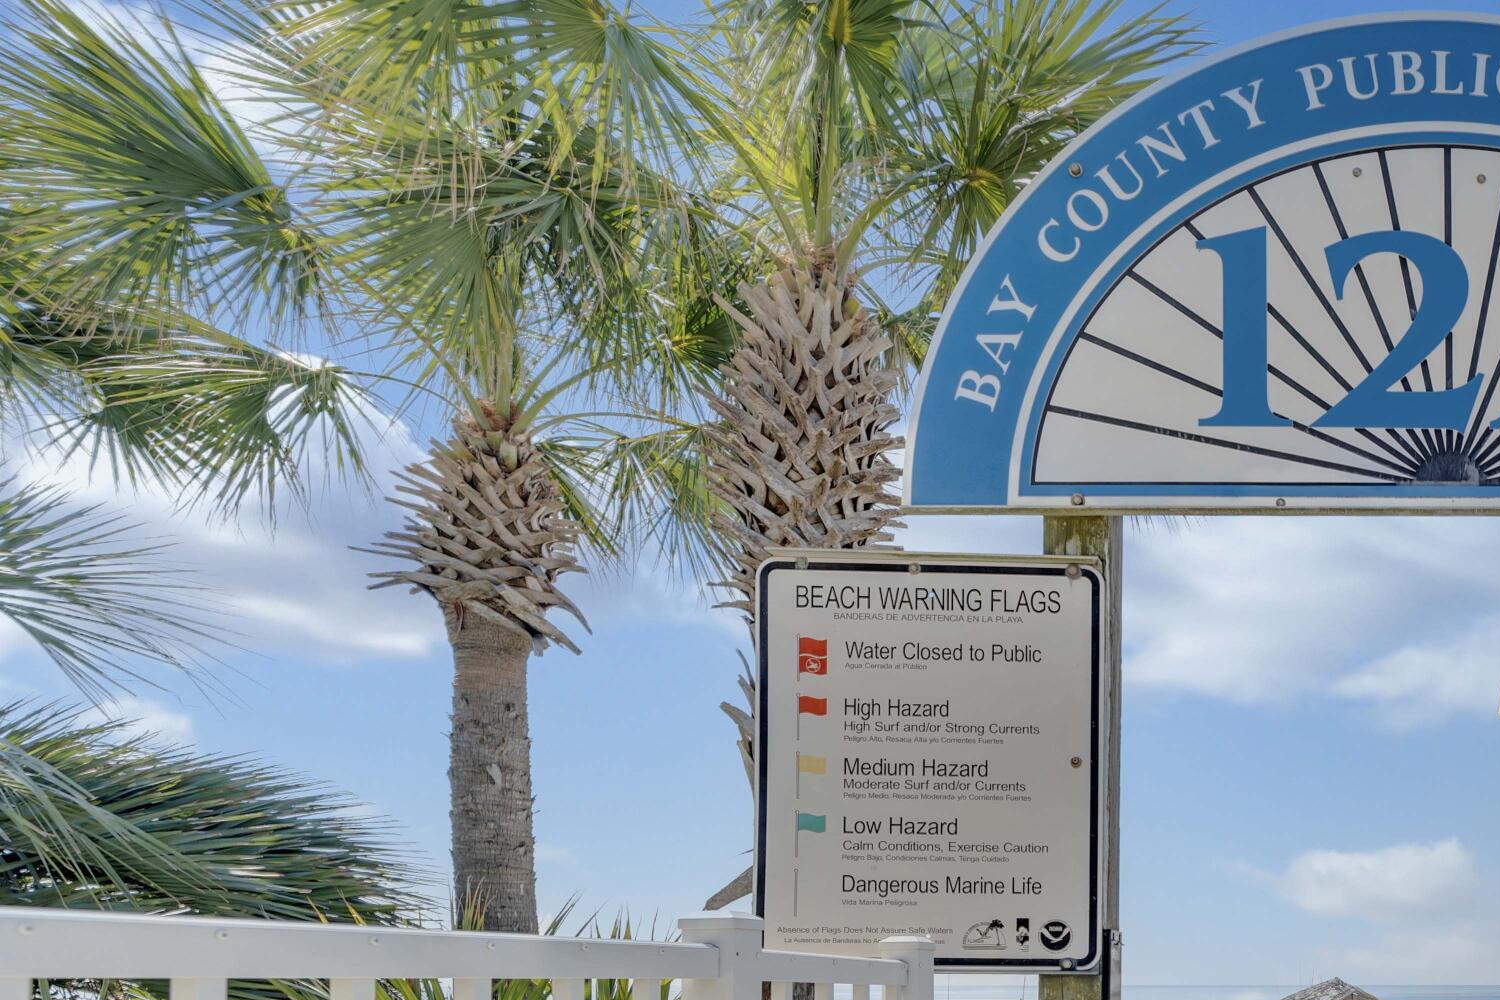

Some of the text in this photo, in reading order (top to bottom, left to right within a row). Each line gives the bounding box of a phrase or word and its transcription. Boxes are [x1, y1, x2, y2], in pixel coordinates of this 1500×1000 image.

[955, 271, 1039, 413] BAY
[1037, 77, 1265, 263] COUNTY
[795, 585, 1062, 614] BEACH WARNING FLAGS
[833, 612, 1023, 624] BANDERAS DE ADVERTENCIA EN LA PLAYA
[845, 641, 1042, 663] Water Closed to Public
[844, 698, 950, 721] High Hazard
[844, 721, 1040, 736] High Surf and/or Strong Currents
[843, 758, 989, 777] Medium Hazard
[843, 779, 1026, 792] Moderate Surf and/or Currents
[842, 816, 959, 836] Low Hazard
[842, 840, 1049, 854] Calm Conditions, Exercise Caution
[842, 874, 1042, 897] Dangerous Marine Life
[777, 926, 954, 935] Absence of Flags Does Not Assure Safe Waters
